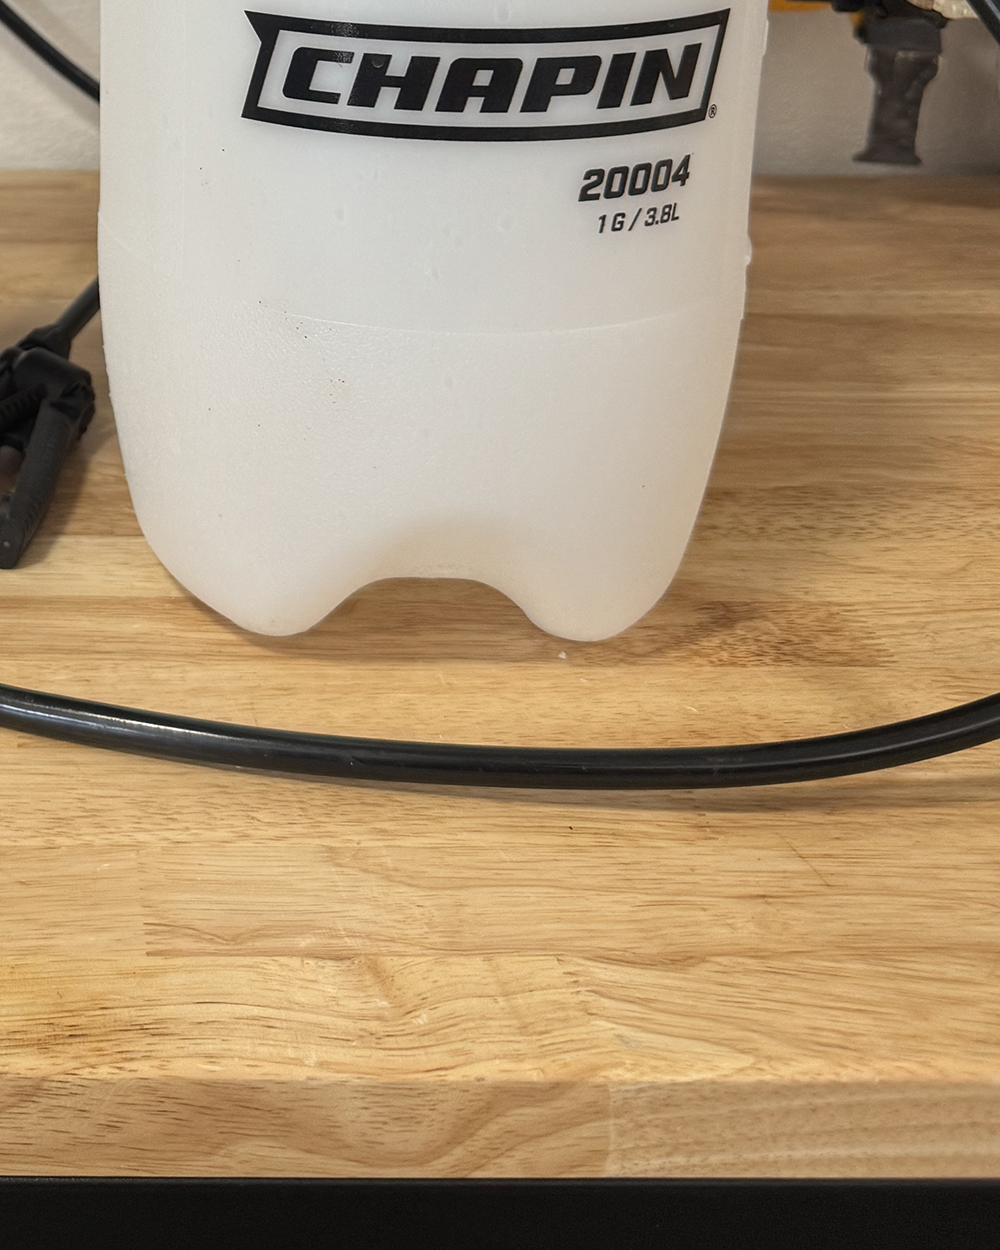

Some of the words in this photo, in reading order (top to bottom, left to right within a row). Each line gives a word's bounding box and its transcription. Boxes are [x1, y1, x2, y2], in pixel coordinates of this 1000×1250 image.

[282, 42, 703, 113] CHAPIN
[578, 154, 691, 202] 20004
[644, 202, 680, 227] 3.8L
